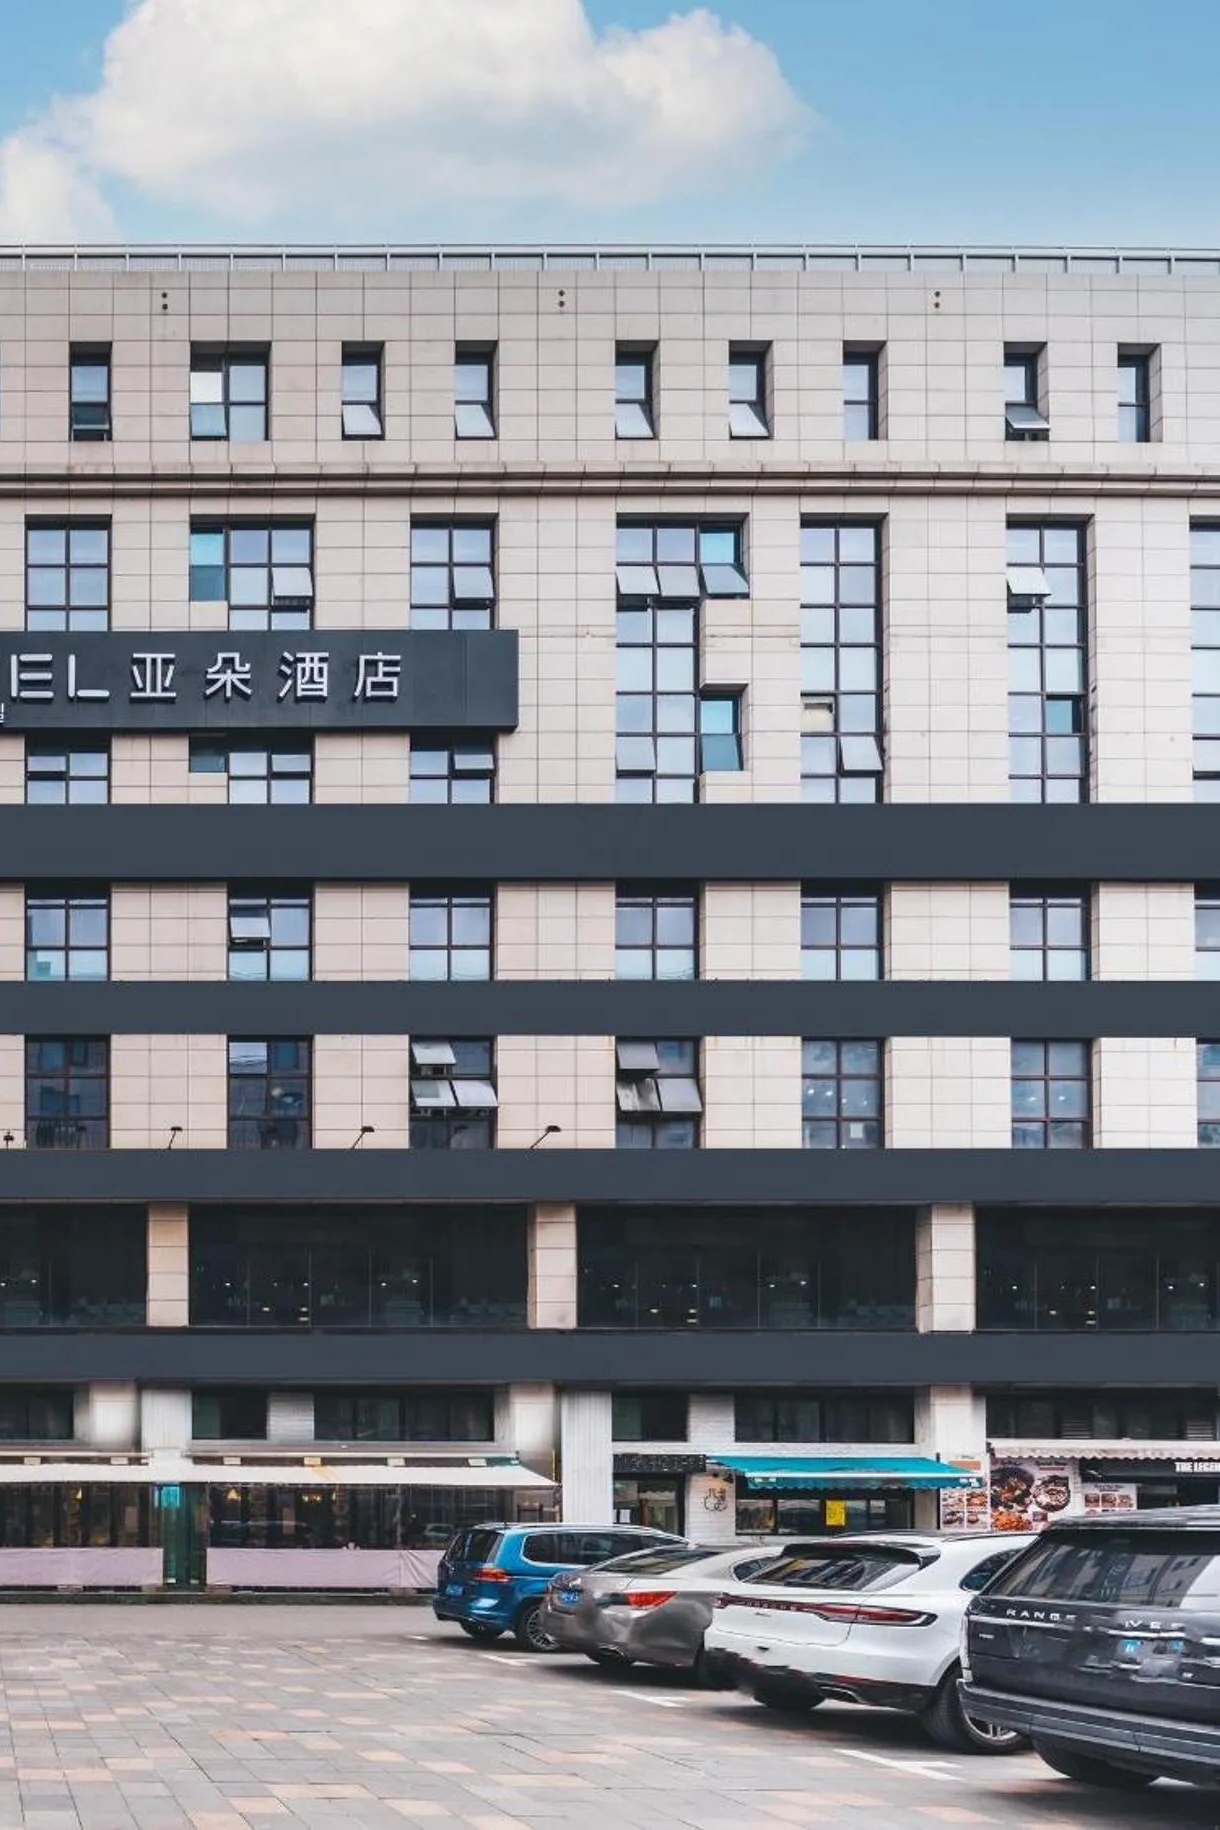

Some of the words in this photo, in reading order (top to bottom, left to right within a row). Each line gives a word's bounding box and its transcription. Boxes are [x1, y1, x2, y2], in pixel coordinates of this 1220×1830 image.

[129, 650, 403, 698] 亚朵酒店
[1174, 1461, 1192, 1473] THE
